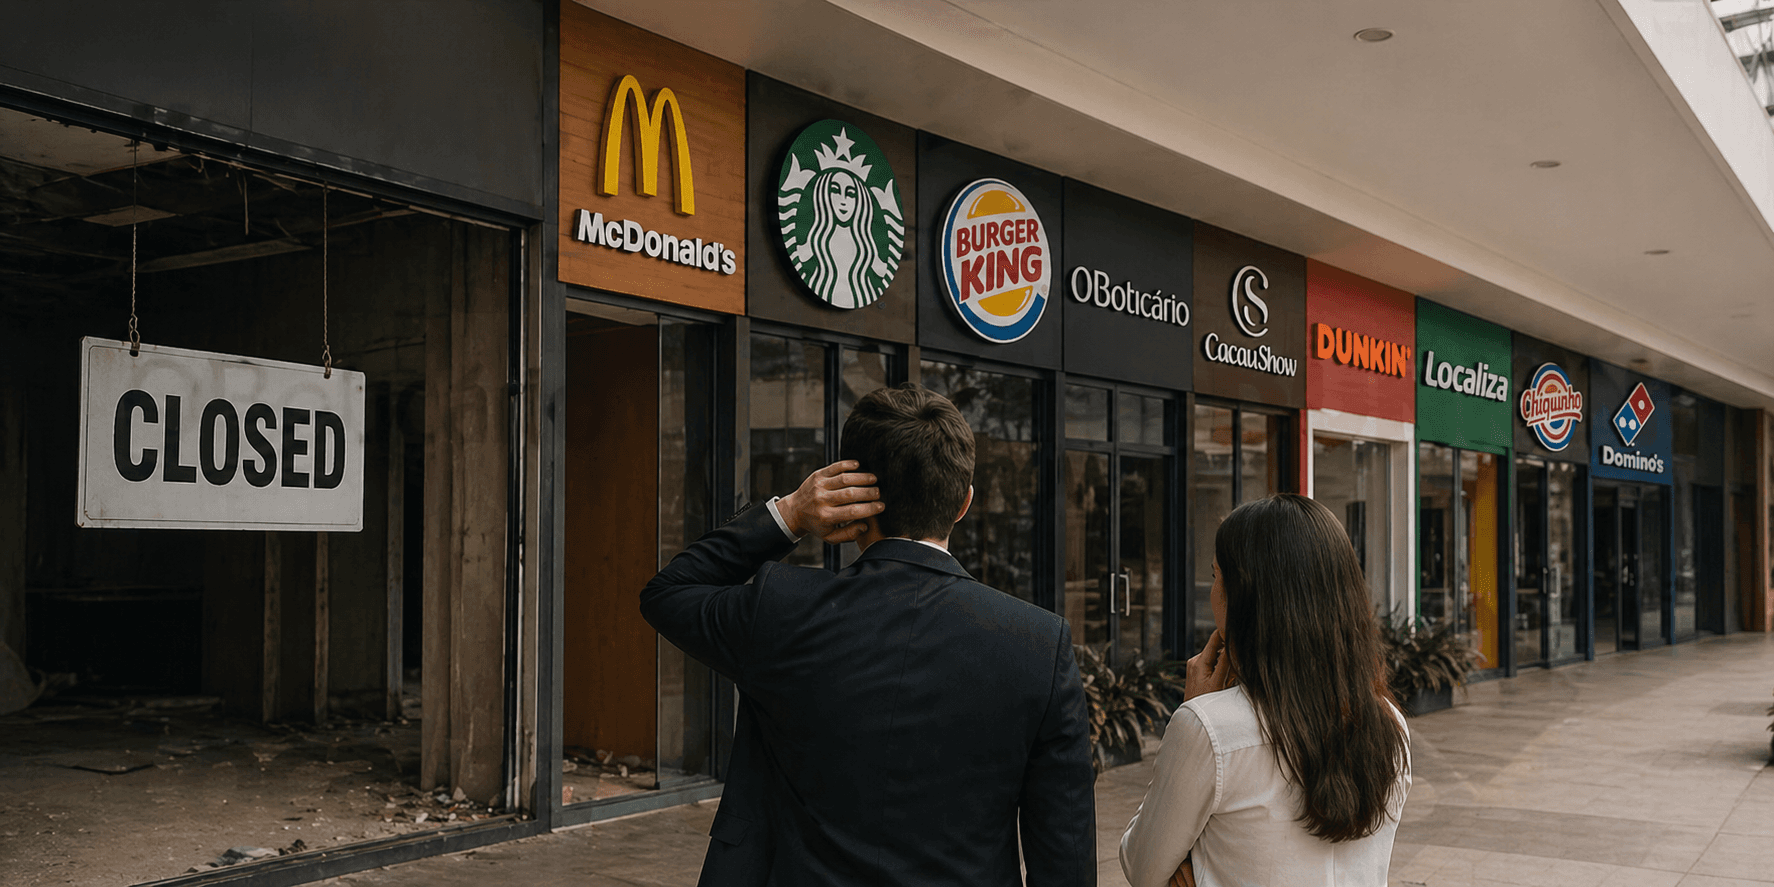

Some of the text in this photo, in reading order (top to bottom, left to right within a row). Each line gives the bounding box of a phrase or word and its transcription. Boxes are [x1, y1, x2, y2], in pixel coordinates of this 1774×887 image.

[577, 208, 737, 275] McDonald's
[956, 218, 1039, 258] BURGER
[960, 245, 1043, 302] KING
[1317, 323, 1411, 378] DUNKIN'
[1425, 350, 1509, 402] Localiza
[1520, 383, 1583, 421] Chiquinho
[113, 388, 346, 490] CLOSED
[1602, 445, 1665, 473] Domino's
